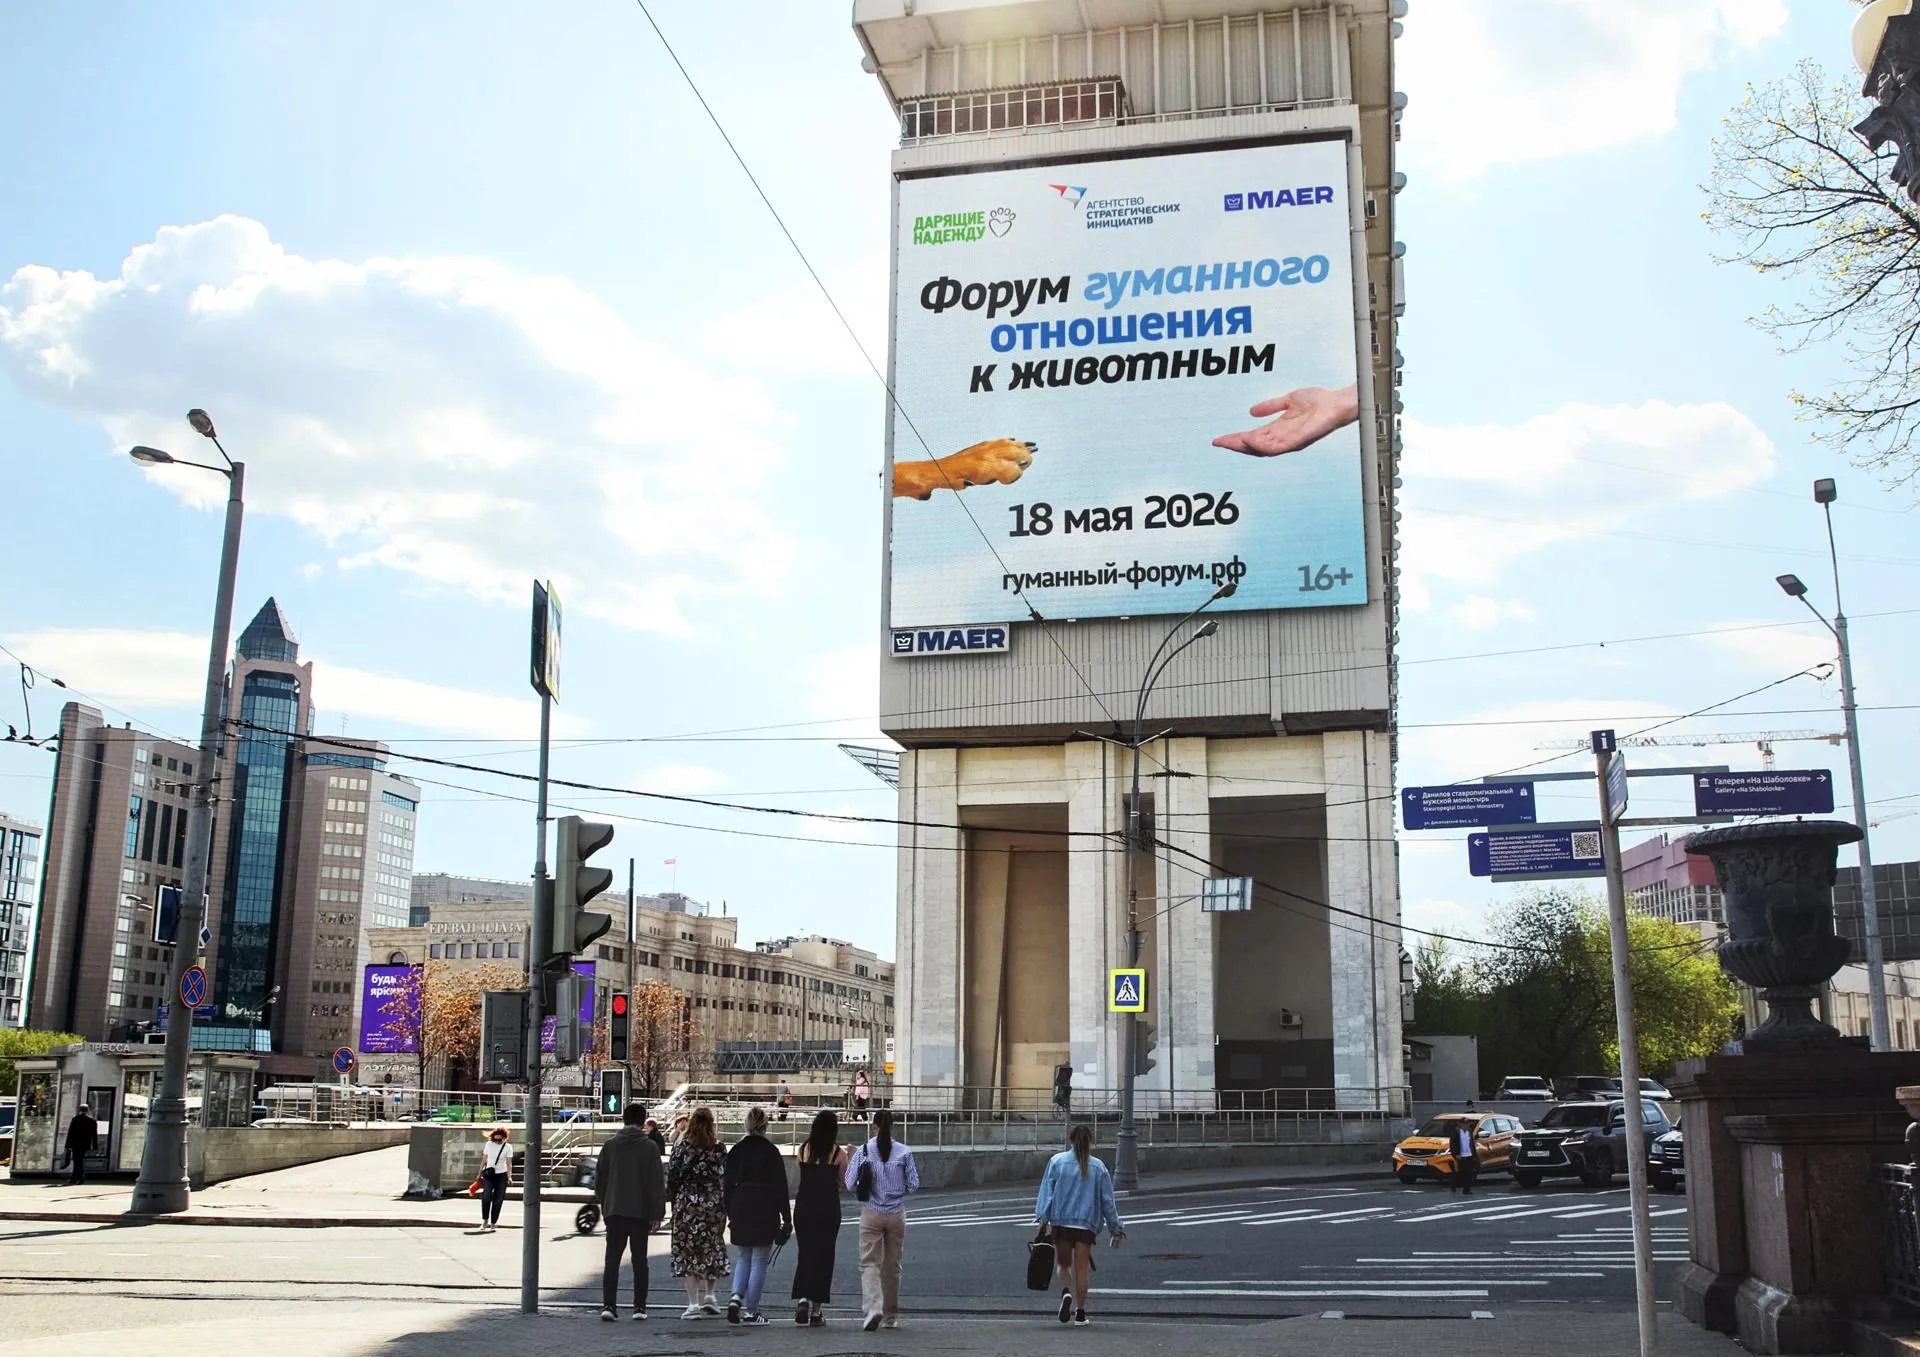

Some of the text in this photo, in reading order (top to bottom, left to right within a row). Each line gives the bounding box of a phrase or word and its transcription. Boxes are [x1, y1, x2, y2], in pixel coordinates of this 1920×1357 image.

[1086, 196, 1145, 209] АГЕНТСТВО
[1247, 186, 1334, 210] MAER
[1086, 203, 1180, 219] СТРАТЕГИЧЕСКИХ
[914, 211, 985, 232] ДАРЯЩИЕ
[1086, 216, 1154, 229] ИНИЦИАТИВ
[914, 226, 986, 245] НАДЕЖДУ
[920, 254, 1330, 318] Форум гуманного
[991, 306, 1252, 353] отношения
[970, 343, 1276, 393] к животным
[1008, 491, 1240, 537] 18 мая 2026
[1002, 555, 1247, 594] гуманный-форум.рф
[1298, 564, 1354, 592] 16+
[918, 628, 1005, 652] MAER
[1714, 777, 1745, 786] Галерея
[1422, 788, 1513, 799] Данилов ставропигиальный
[1715, 786, 1736, 794] Gallery
[1453, 796, 1489, 804] монастырь
[430, 922, 522, 933] ЕРЕВАН ПЛАЗА
[371, 973, 397, 986] будь
[87, 1042, 130, 1052] ПРЕССА
[363, 1064, 415, 1073] ЛЭТУАЛЬ
